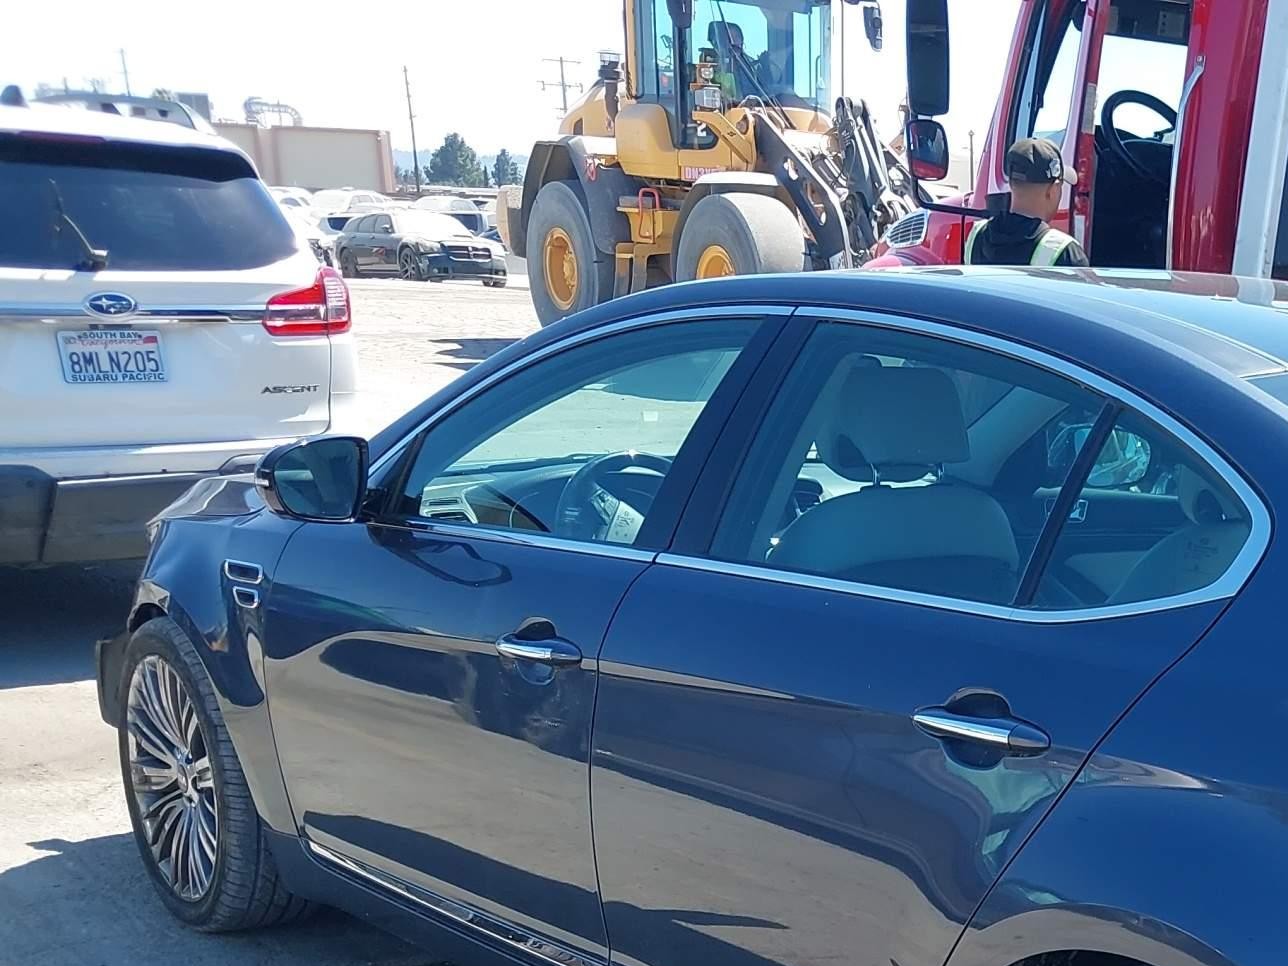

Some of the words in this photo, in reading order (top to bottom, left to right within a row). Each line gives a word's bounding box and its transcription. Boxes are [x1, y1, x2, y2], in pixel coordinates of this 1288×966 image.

[82, 331, 117, 339] SOUTH
[120, 331, 139, 339] BAY
[69, 350, 160, 374] 8MLN205
[71, 373, 118, 382] SUBARU
[122, 372, 166, 381] PACIFIC
[260, 384, 320, 394] ASCENT
